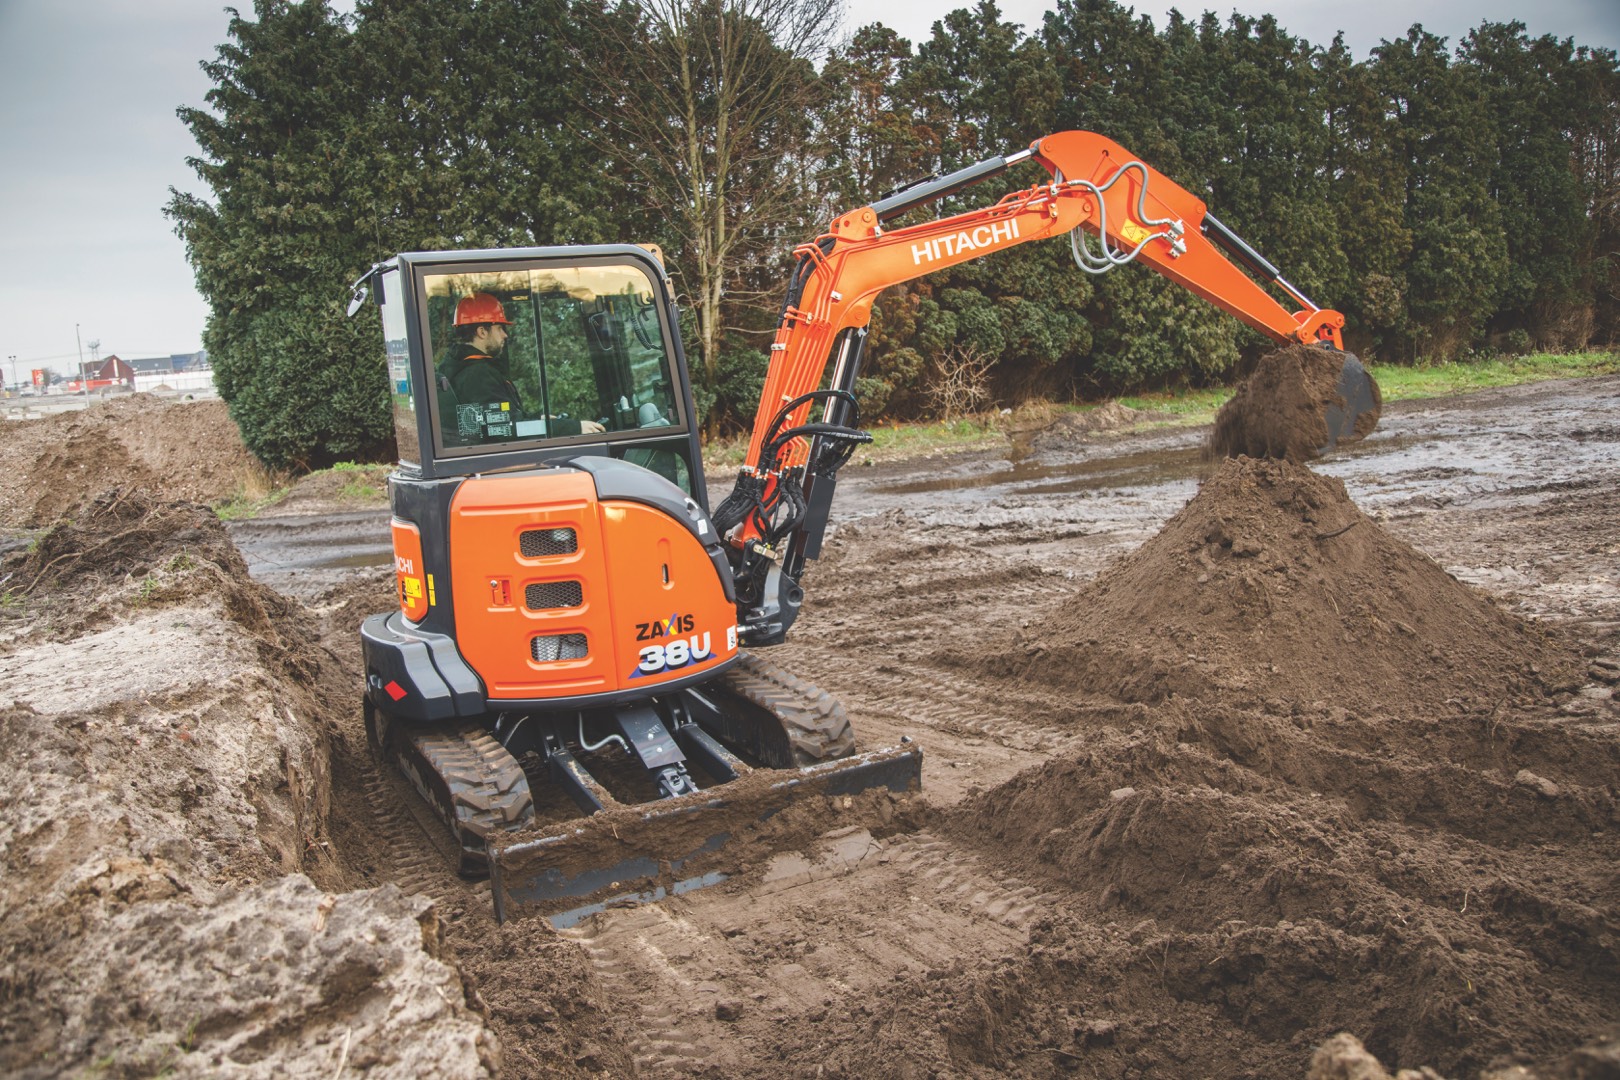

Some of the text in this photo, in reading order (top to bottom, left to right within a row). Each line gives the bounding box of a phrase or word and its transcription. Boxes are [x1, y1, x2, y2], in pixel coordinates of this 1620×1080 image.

[911, 218, 1019, 265] HITACHI
[636, 613, 695, 641] ZAXIS
[638, 631, 711, 674] 38U
